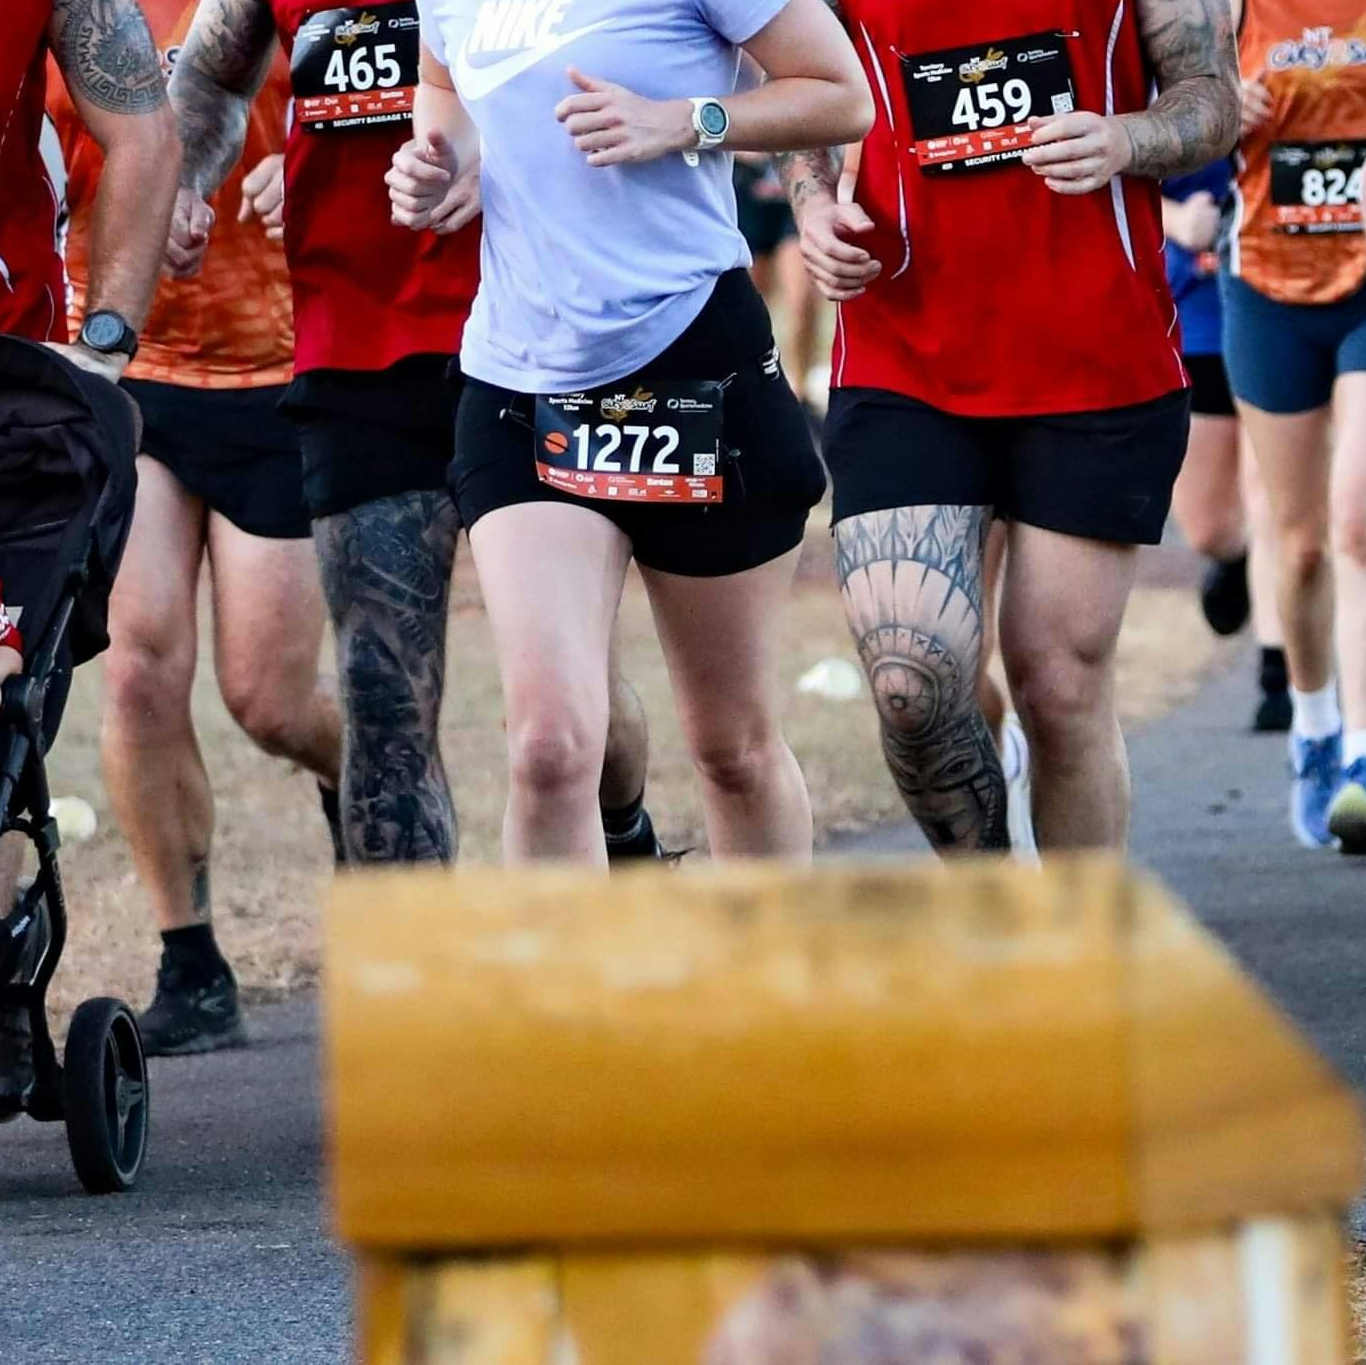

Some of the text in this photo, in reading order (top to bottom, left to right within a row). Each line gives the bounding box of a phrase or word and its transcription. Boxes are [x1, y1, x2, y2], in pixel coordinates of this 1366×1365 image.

[1302, 26, 1333, 43] NT
[324, 43, 402, 92] 465
[952, 78, 1033, 131] 459
[964, 154, 1001, 167] SECURITY
[1301, 168, 1364, 206] 824
[573, 423, 680, 473] 1272
